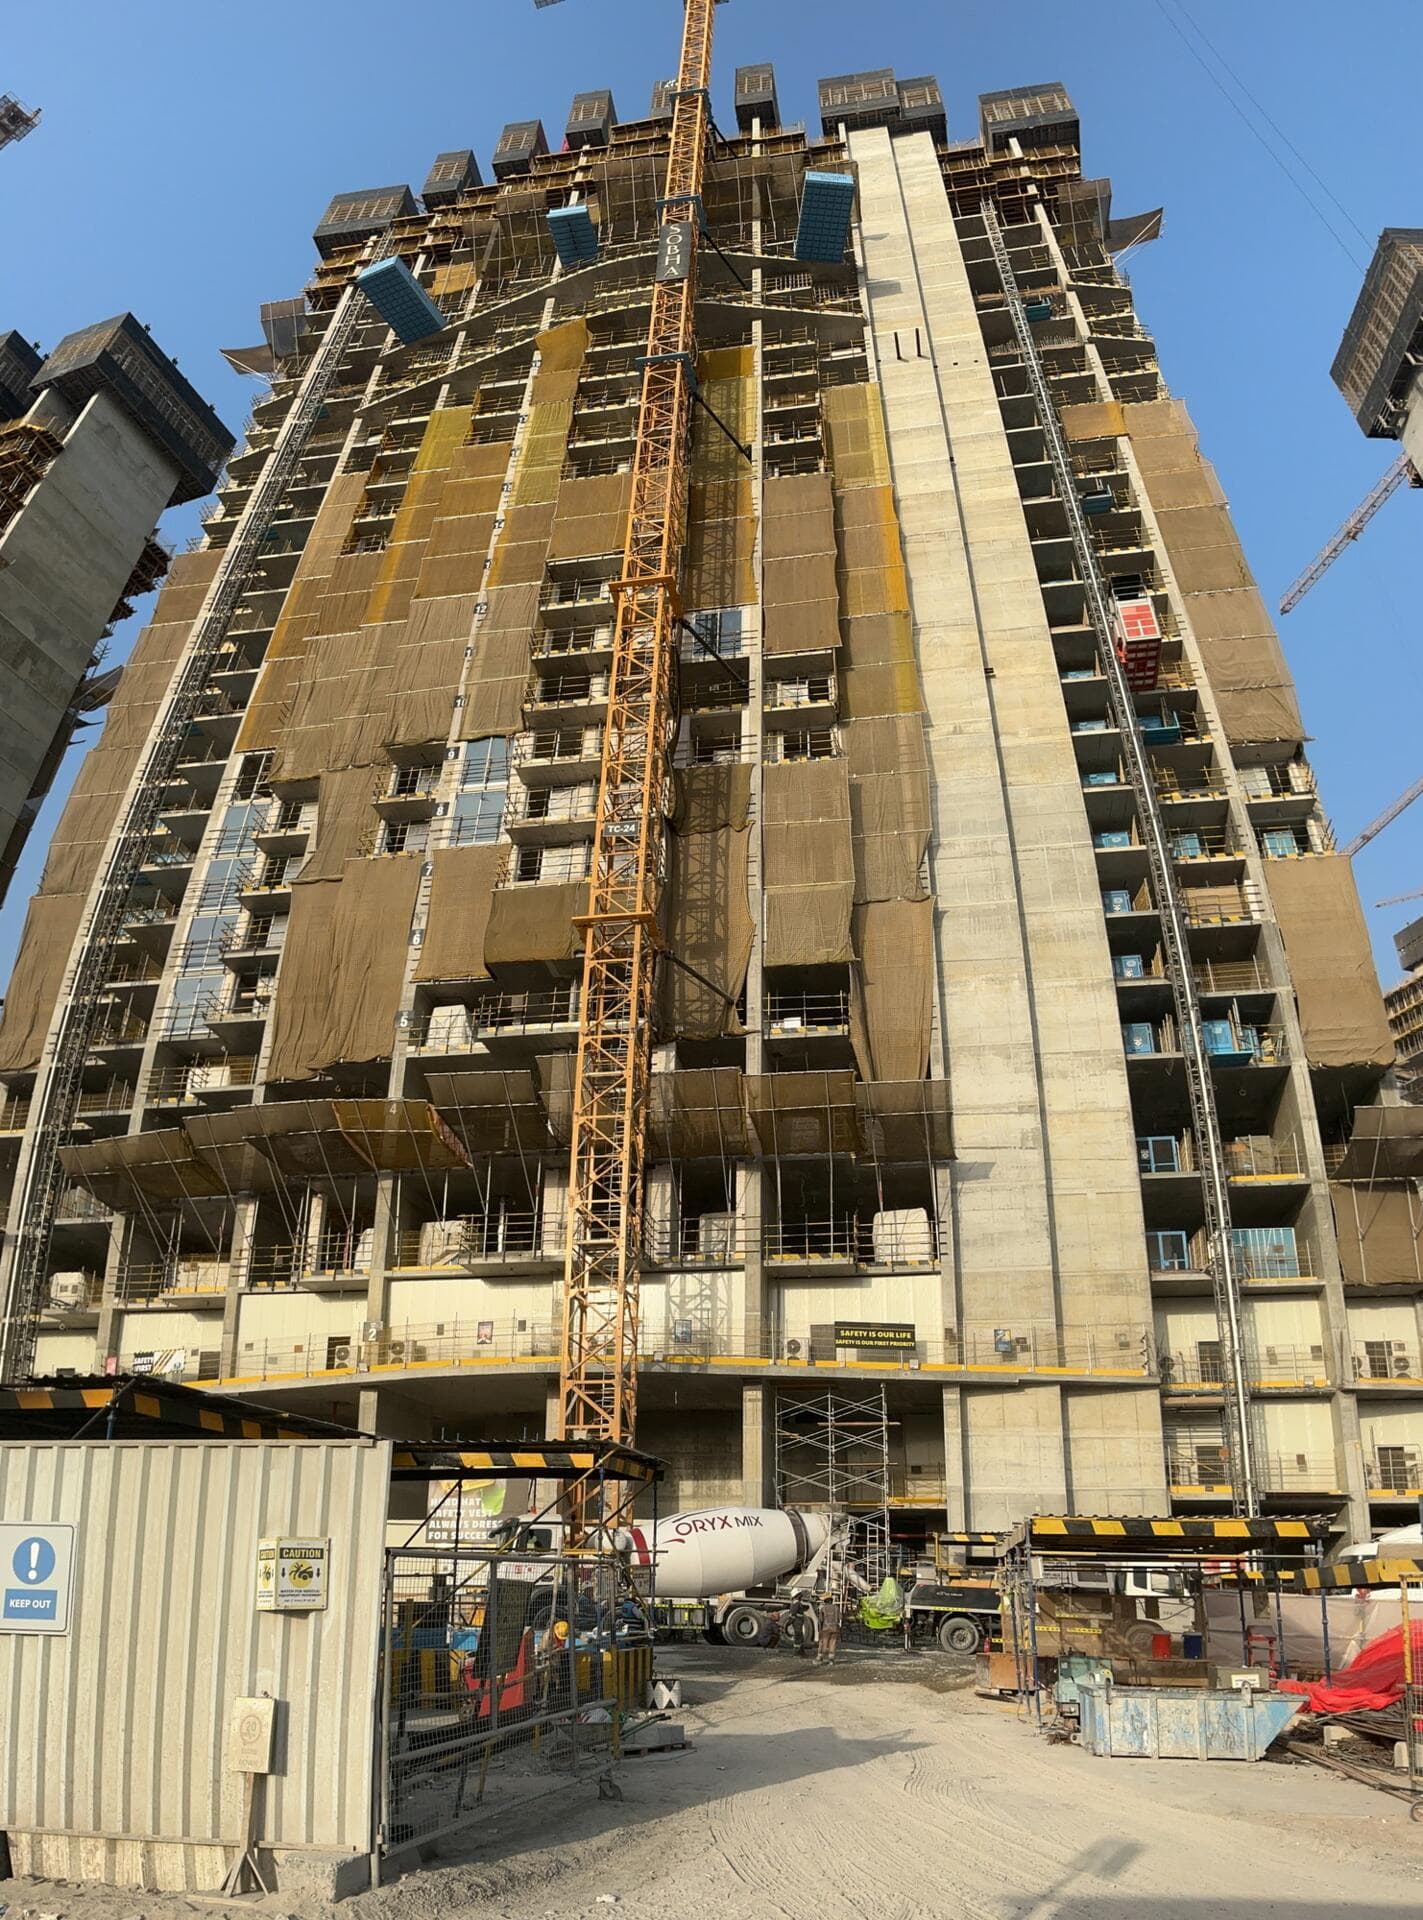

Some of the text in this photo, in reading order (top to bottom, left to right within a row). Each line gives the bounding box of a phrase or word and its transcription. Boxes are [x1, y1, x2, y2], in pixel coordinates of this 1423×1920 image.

[664, 223, 683, 277] SOBHA
[475, 605, 488, 614] 12
[448, 750, 455, 760] 9
[436, 806, 444, 816] 8
[608, 824, 636, 833] TC-24
[425, 865, 433, 876] 7
[413, 933, 421, 944] 6
[400, 1015, 408, 1027] 5
[389, 1103, 397, 1114] 4
[368, 1328, 377, 1342] 2
[133, 1356, 153, 1364] SAFETY
[675, 1515, 763, 1536] ORYX MIX
[428, 1532, 448, 1540] FOR
[283, 1548, 321, 1558] CAUTION
[9, 1599, 52, 1609] KEEP OUT
